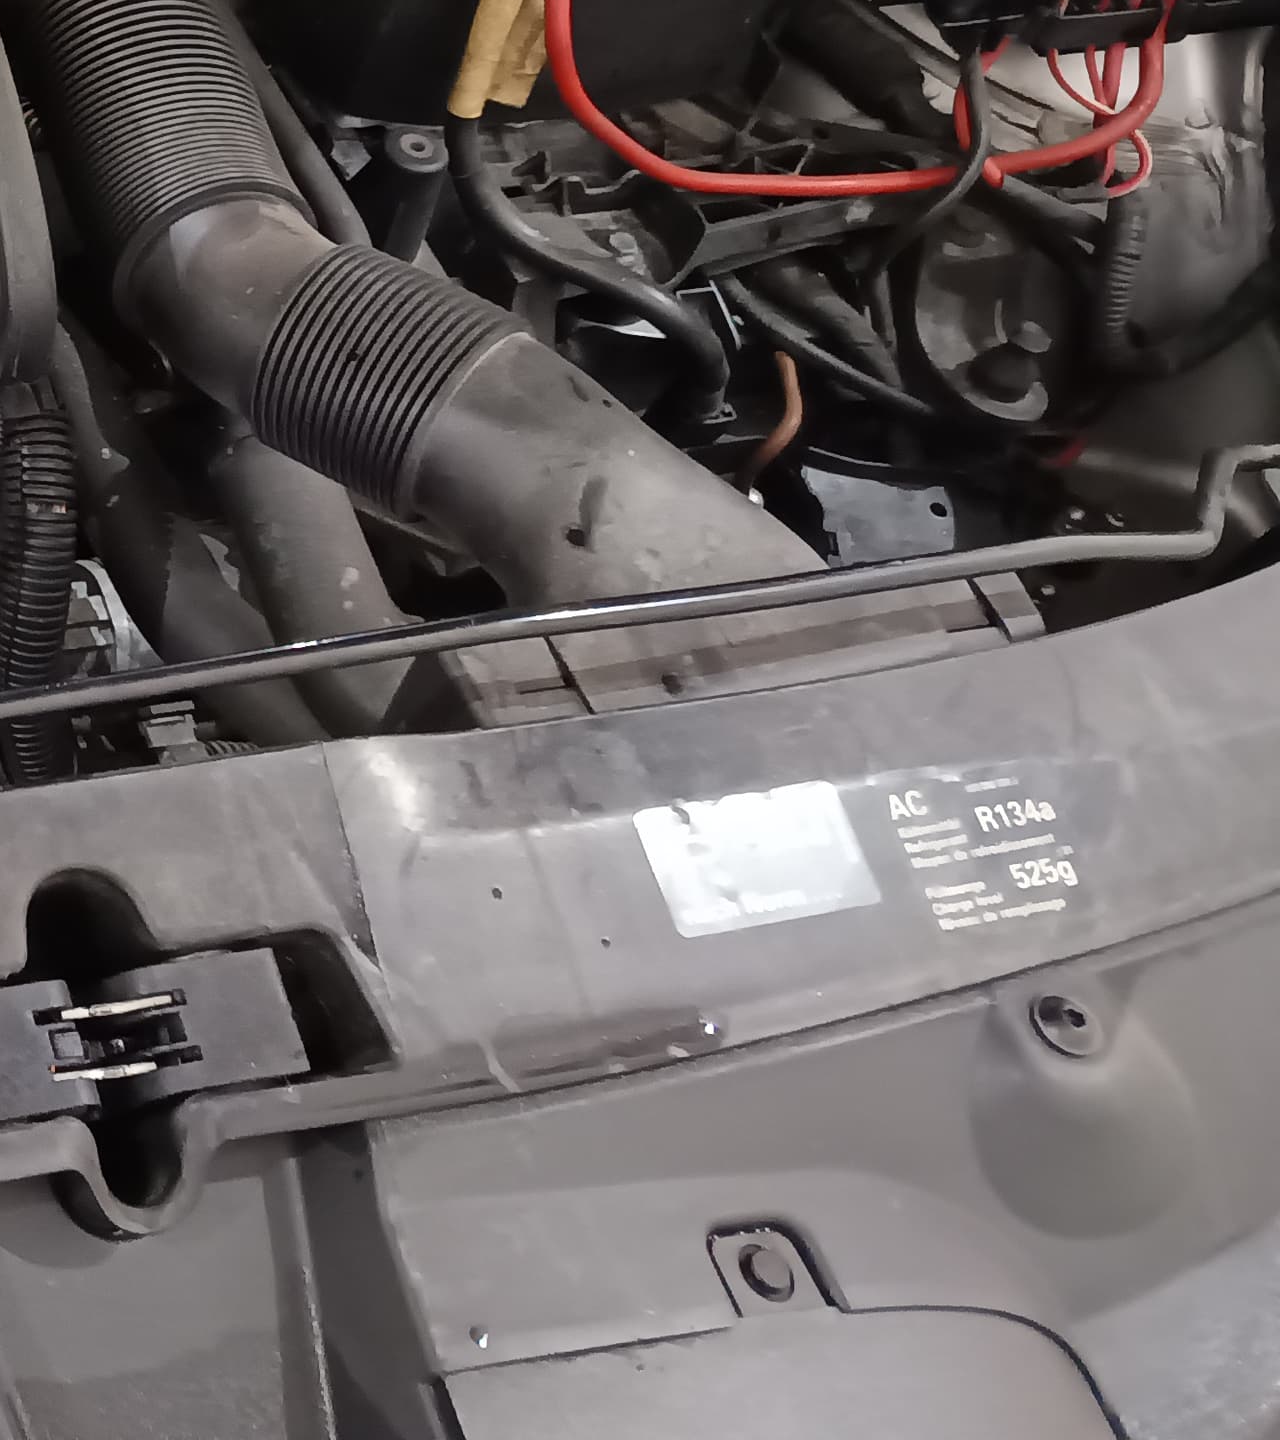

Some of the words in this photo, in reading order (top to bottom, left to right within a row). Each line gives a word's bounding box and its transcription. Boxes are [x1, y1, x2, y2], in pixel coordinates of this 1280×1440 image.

[889, 790, 928, 820] AC
[974, 798, 1057, 832] R134a
[1009, 858, 1079, 888] 525g
